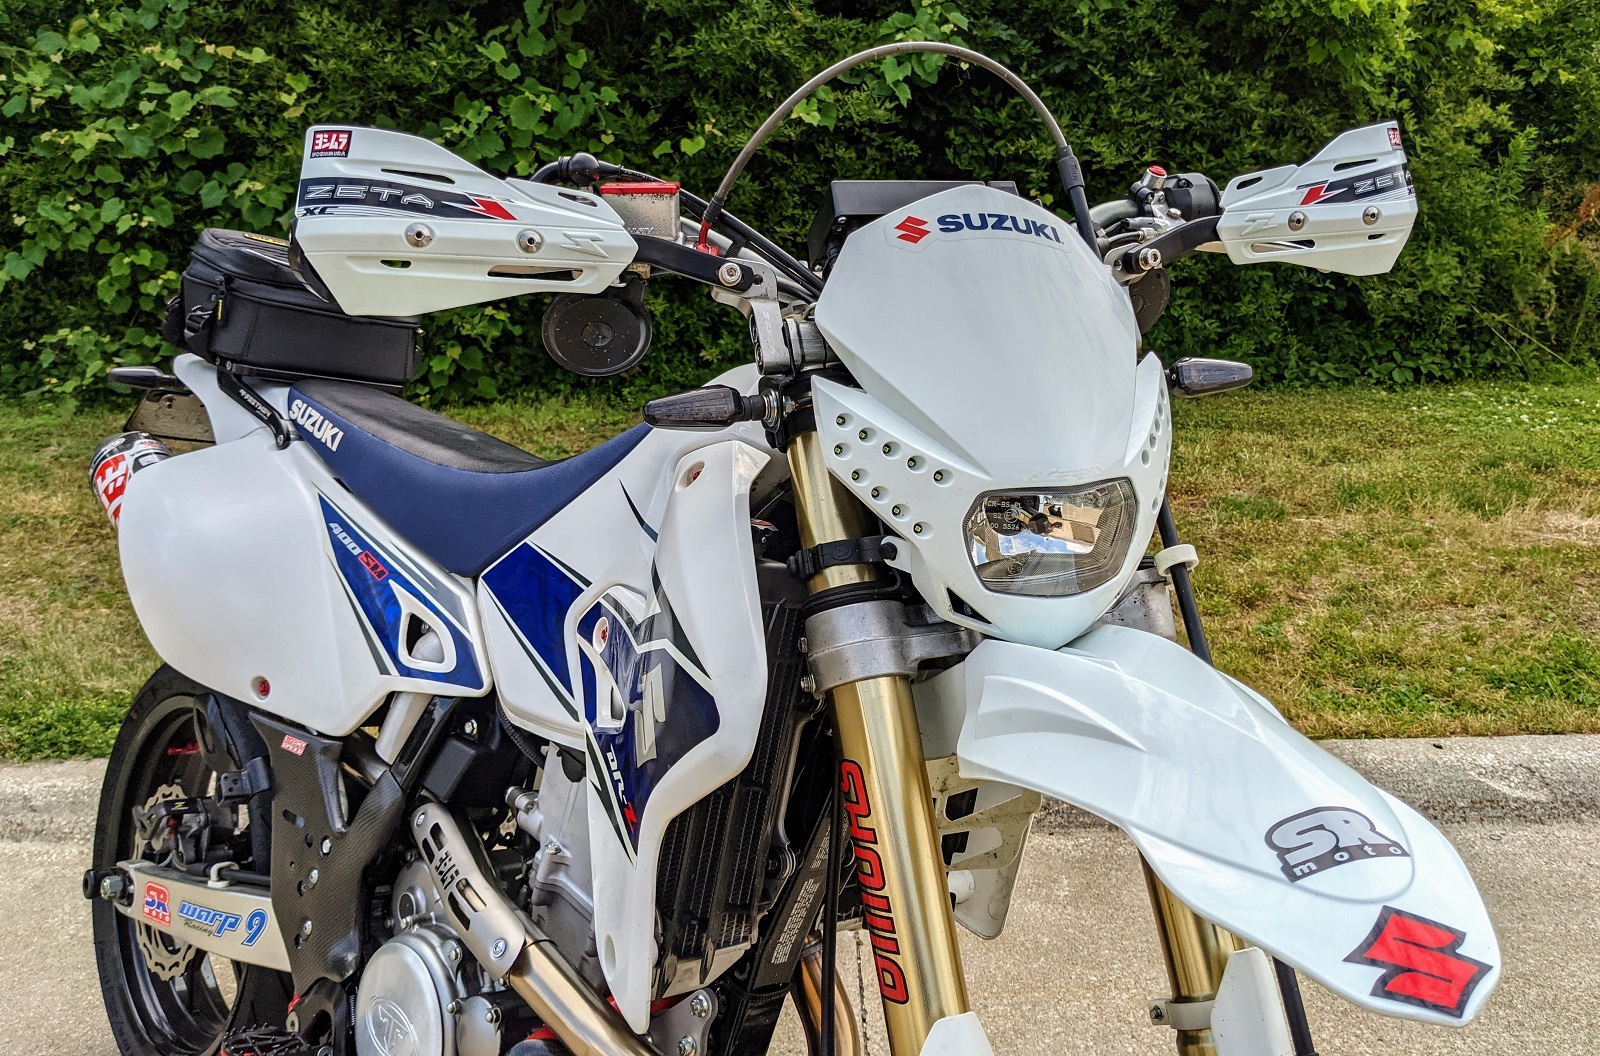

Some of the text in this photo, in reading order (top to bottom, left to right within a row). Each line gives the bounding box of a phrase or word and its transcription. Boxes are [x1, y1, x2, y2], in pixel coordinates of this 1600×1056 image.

[311, 150, 346, 158] YOSHIMURA
[301, 206, 339, 217] XC
[304, 184, 435, 209] ZETA
[936, 212, 1064, 245] SUZUKI
[289, 399, 345, 452] SUZUKI
[1271, 810, 1395, 866] SR
[1293, 845, 1401, 877] moto
[840, 758, 910, 1005] SHOWA
[178, 901, 268, 946] warp 9
[184, 919, 214, 937] Racing
